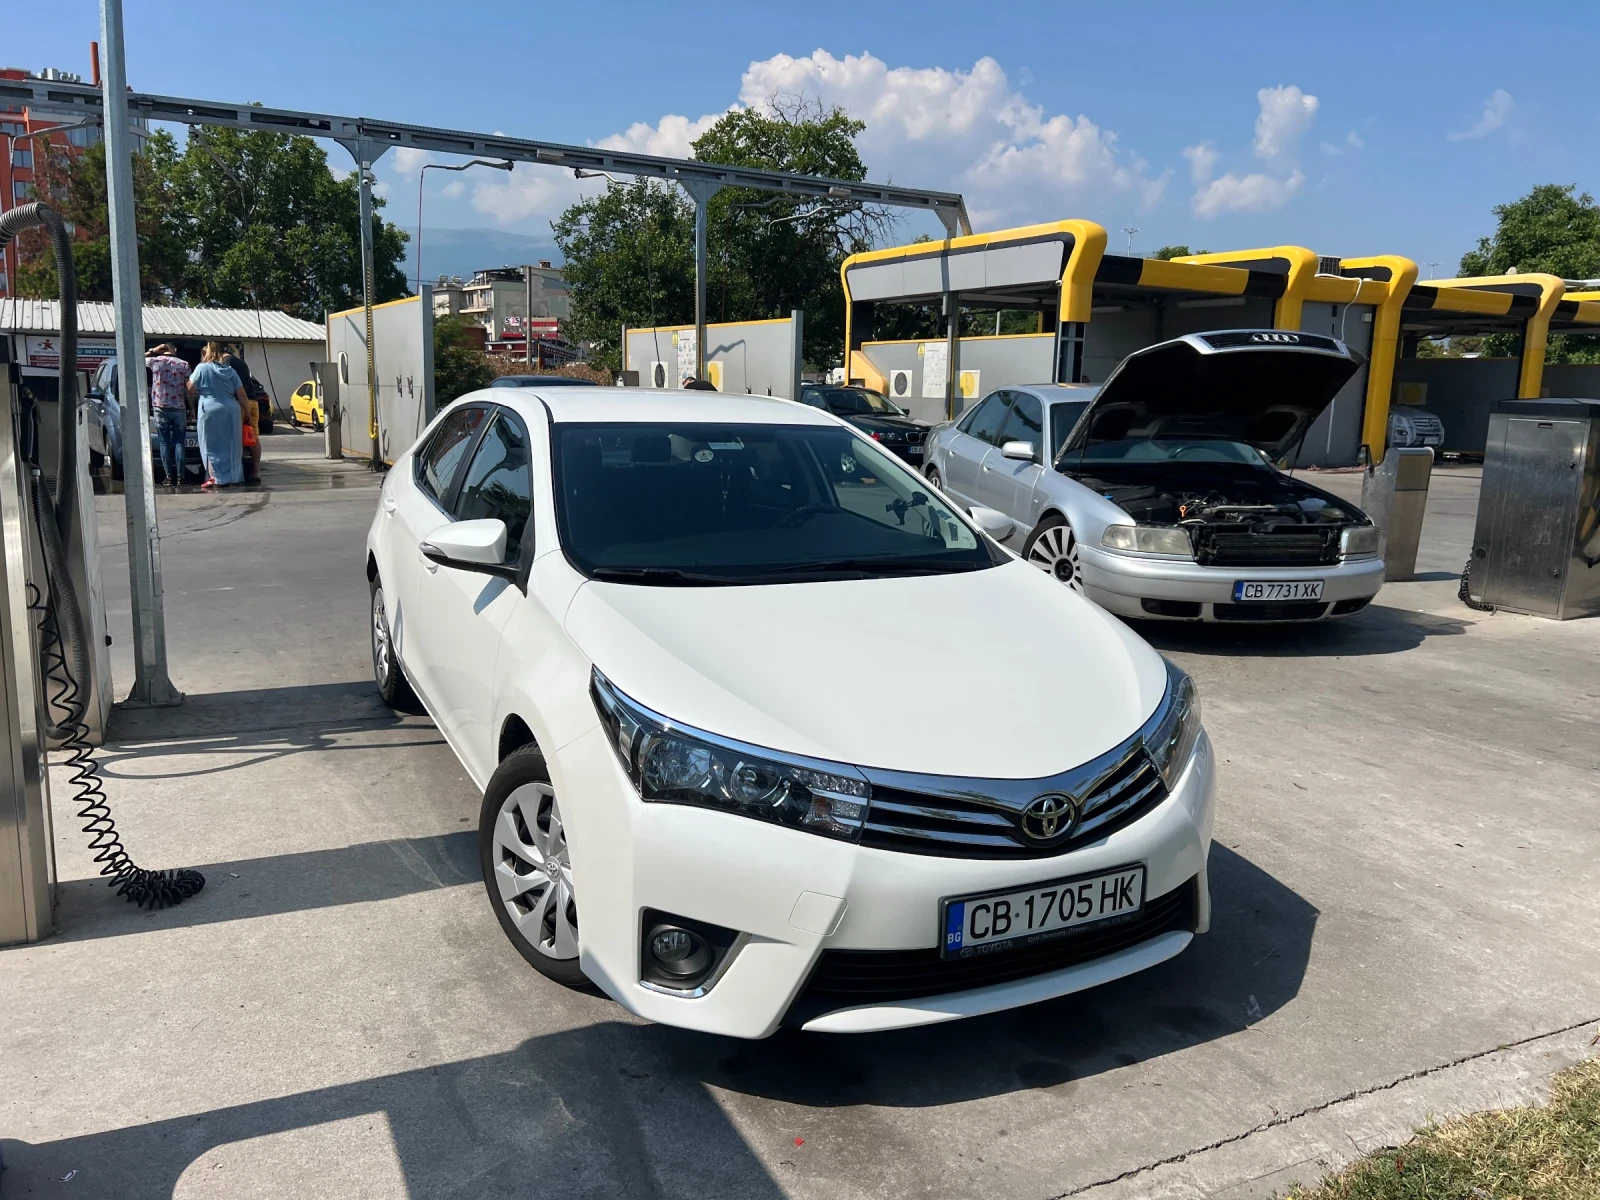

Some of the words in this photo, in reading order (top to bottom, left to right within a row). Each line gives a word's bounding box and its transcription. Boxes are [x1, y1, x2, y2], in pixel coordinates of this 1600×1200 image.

[1245, 584, 1263, 598] CB
[1266, 584, 1299, 598] 7731
[1301, 583, 1320, 597] XK
[970, 900, 1012, 939] CB
[1024, 883, 1093, 929] 1705
[1100, 874, 1136, 914] HK
[947, 932, 961, 944] BG
[976, 940, 1013, 955] TOYOTA
